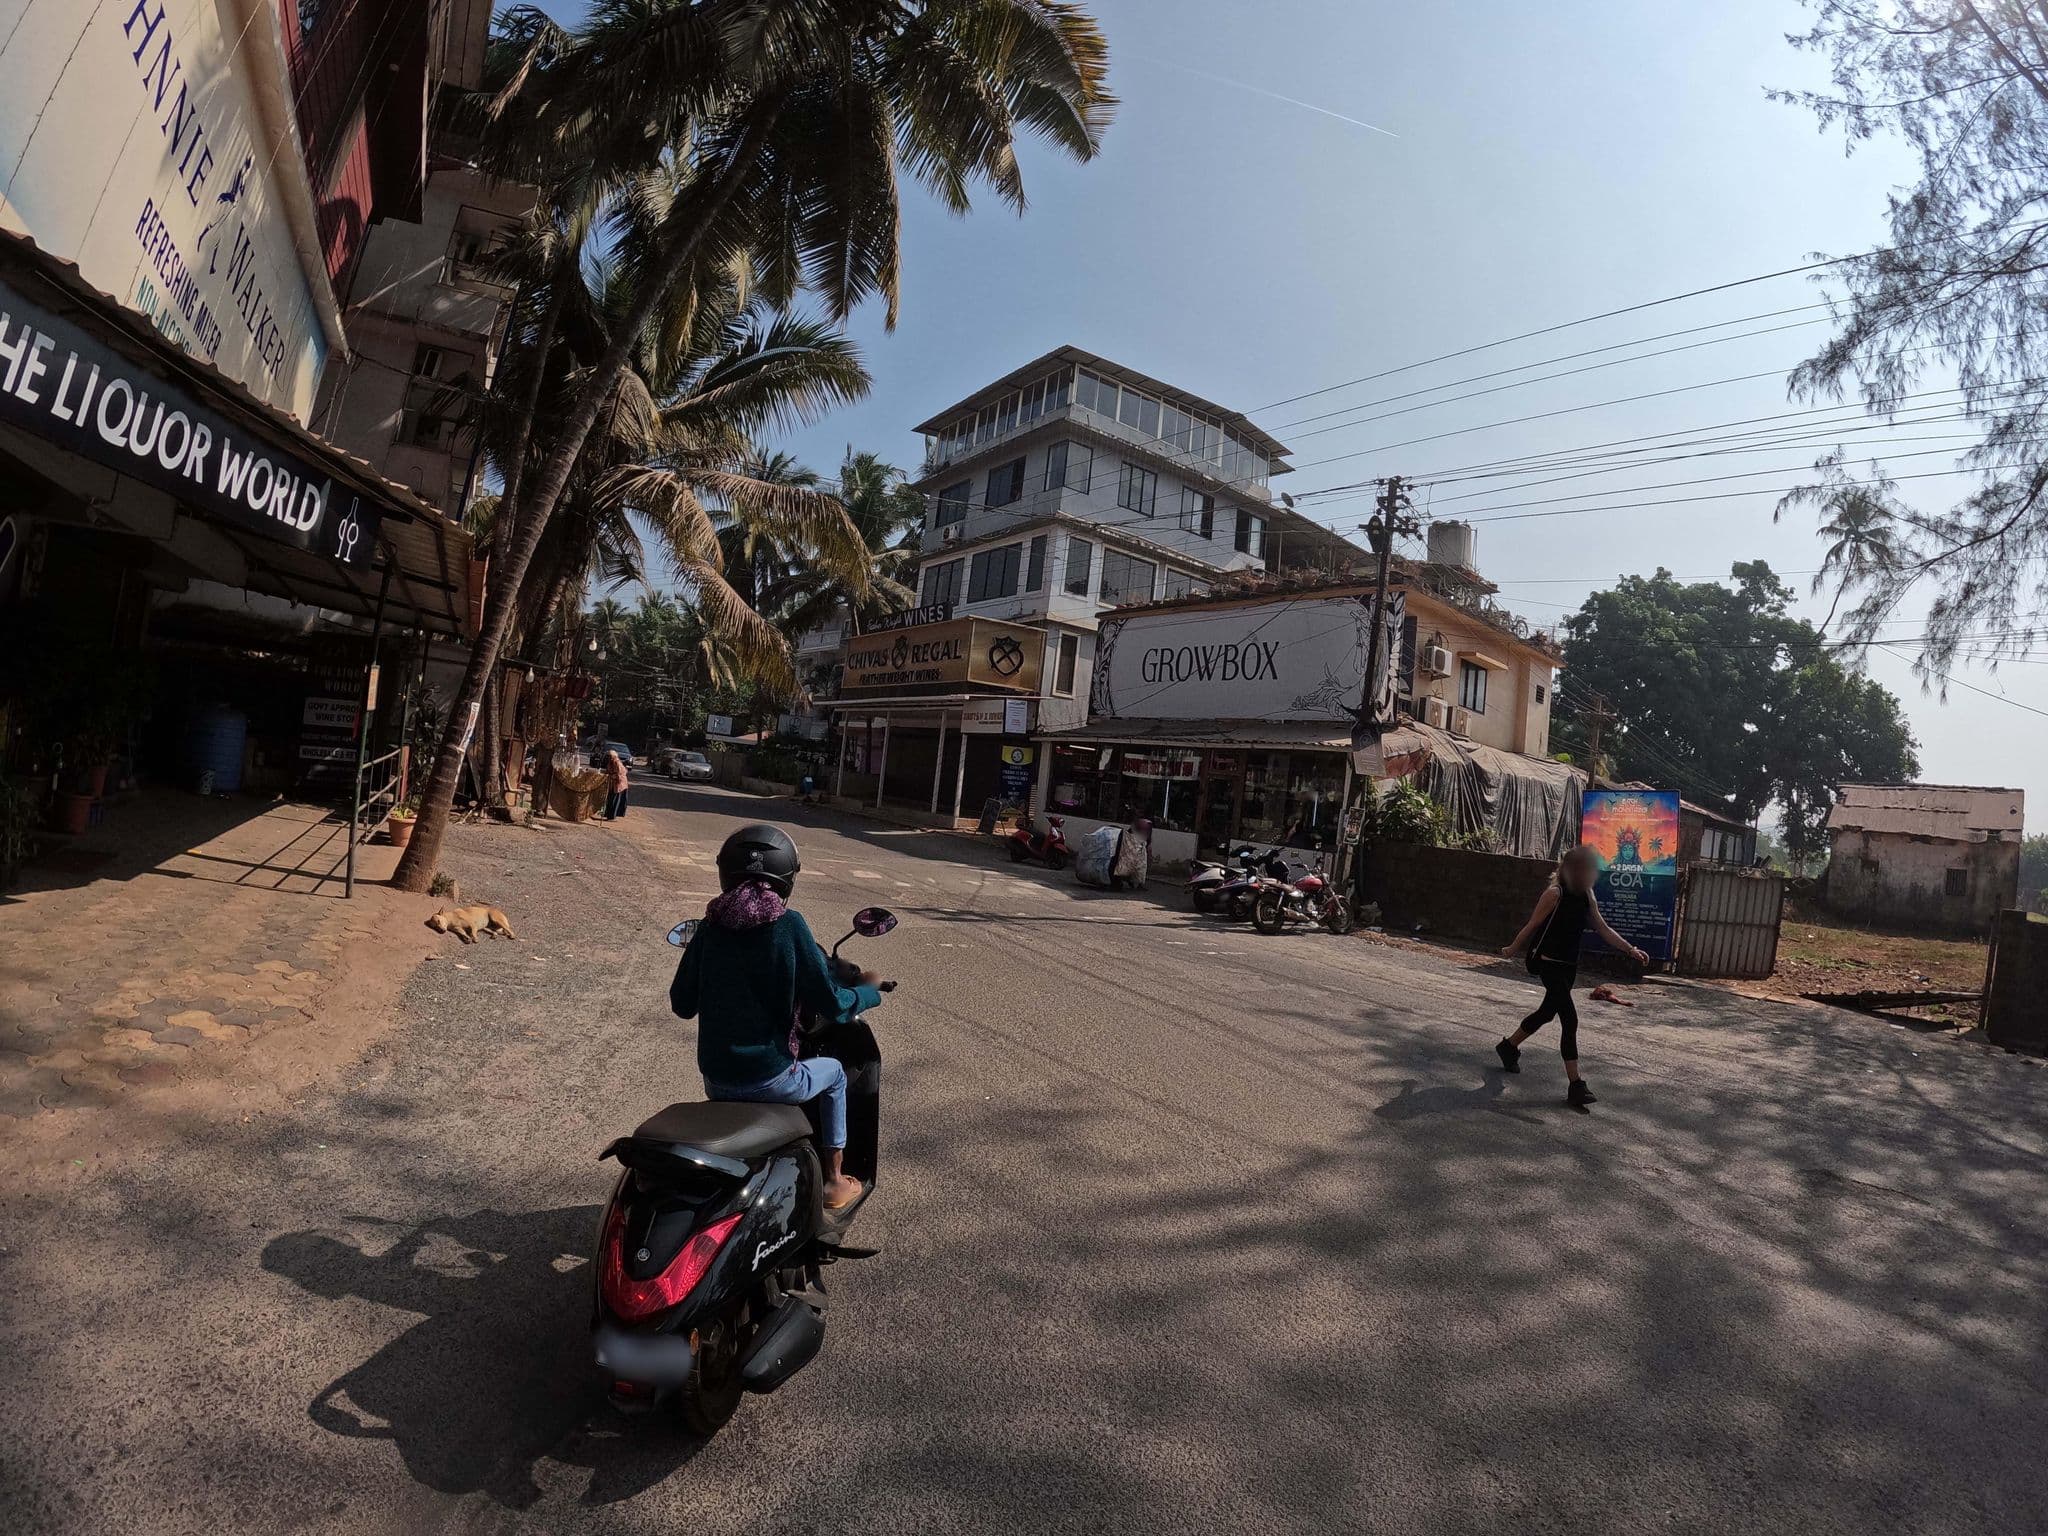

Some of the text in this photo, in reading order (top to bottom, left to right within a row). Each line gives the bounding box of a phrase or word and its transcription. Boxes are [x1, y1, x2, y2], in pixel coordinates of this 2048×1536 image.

[123, 0, 285, 380] HNNIE WALKER
[135, 197, 199, 322] REFRESHING
[0, 312, 323, 532] HE LIQUOR WORLD
[903, 605, 944, 626] WINES
[848, 639, 962, 669] CHIVAS REGAL
[1142, 641, 1279, 683] GROWBOX
[336, 714, 355, 722] STO
[1609, 872, 1643, 888] GOA
